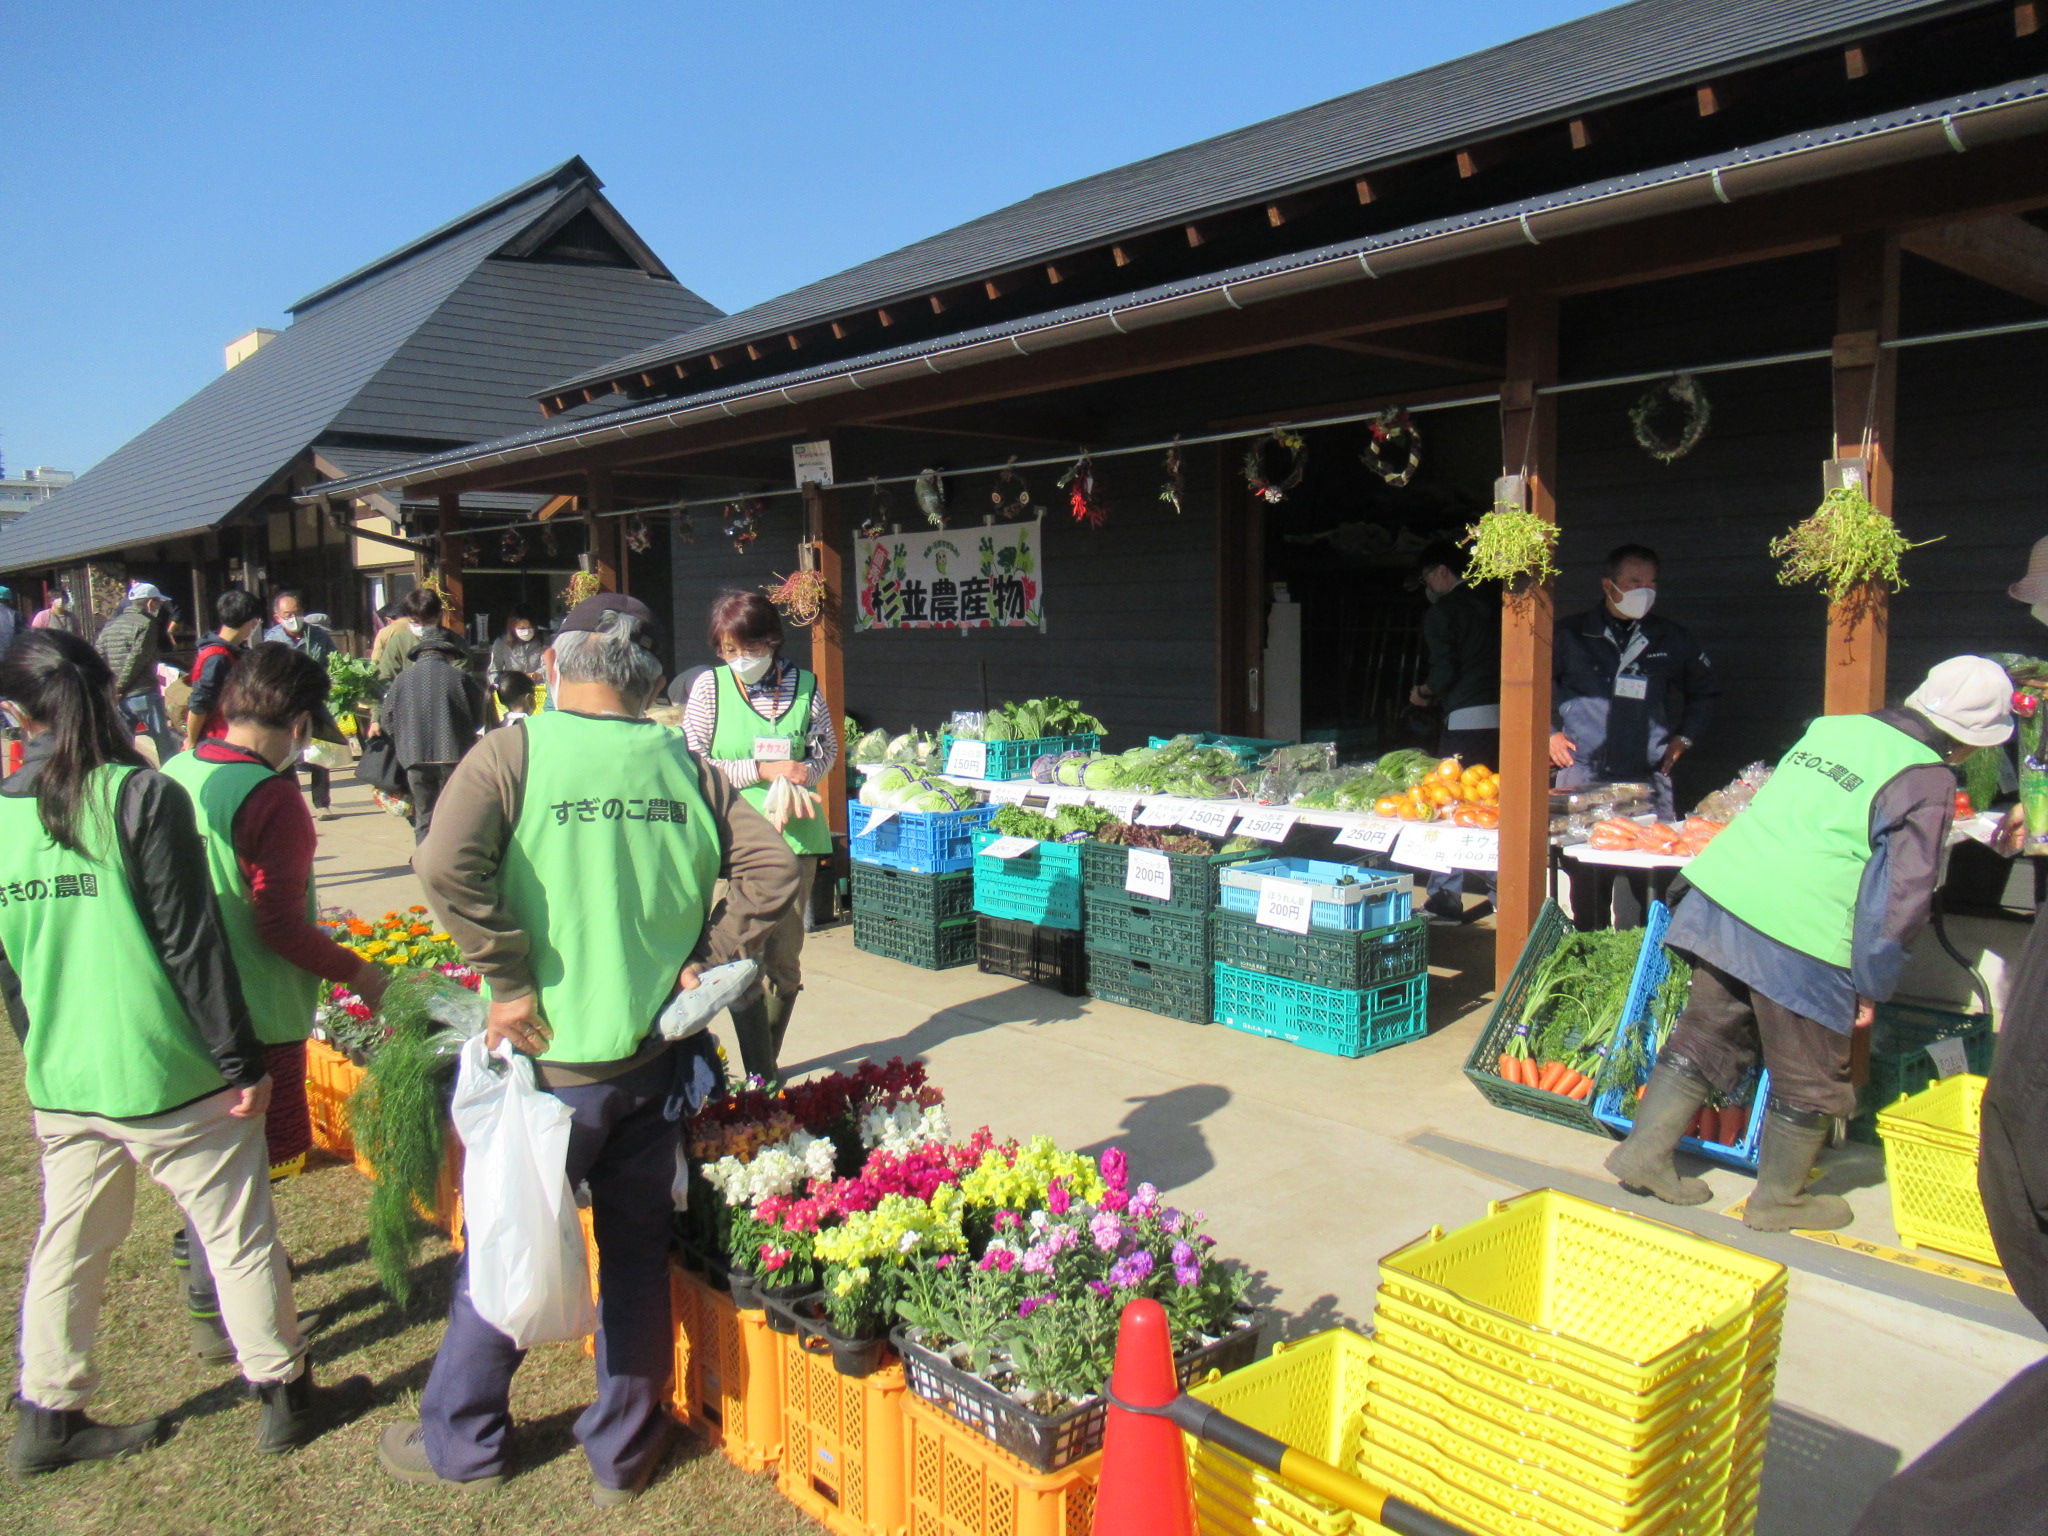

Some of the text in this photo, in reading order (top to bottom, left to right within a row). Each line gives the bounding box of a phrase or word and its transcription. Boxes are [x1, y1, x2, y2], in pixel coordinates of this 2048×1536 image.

[872, 575, 1026, 622] 杉並農産物
[953, 758, 980, 772] 150円
[551, 797, 687, 826] すぎのこ農園
[1188, 810, 1225, 828] 150円
[1245, 819, 1285, 835] 150円
[1424, 828, 1441, 843] 柿
[1346, 829, 1386, 845] 250円
[1135, 866, 1164, 885] 200円
[1269, 902, 1300, 920] 200円
